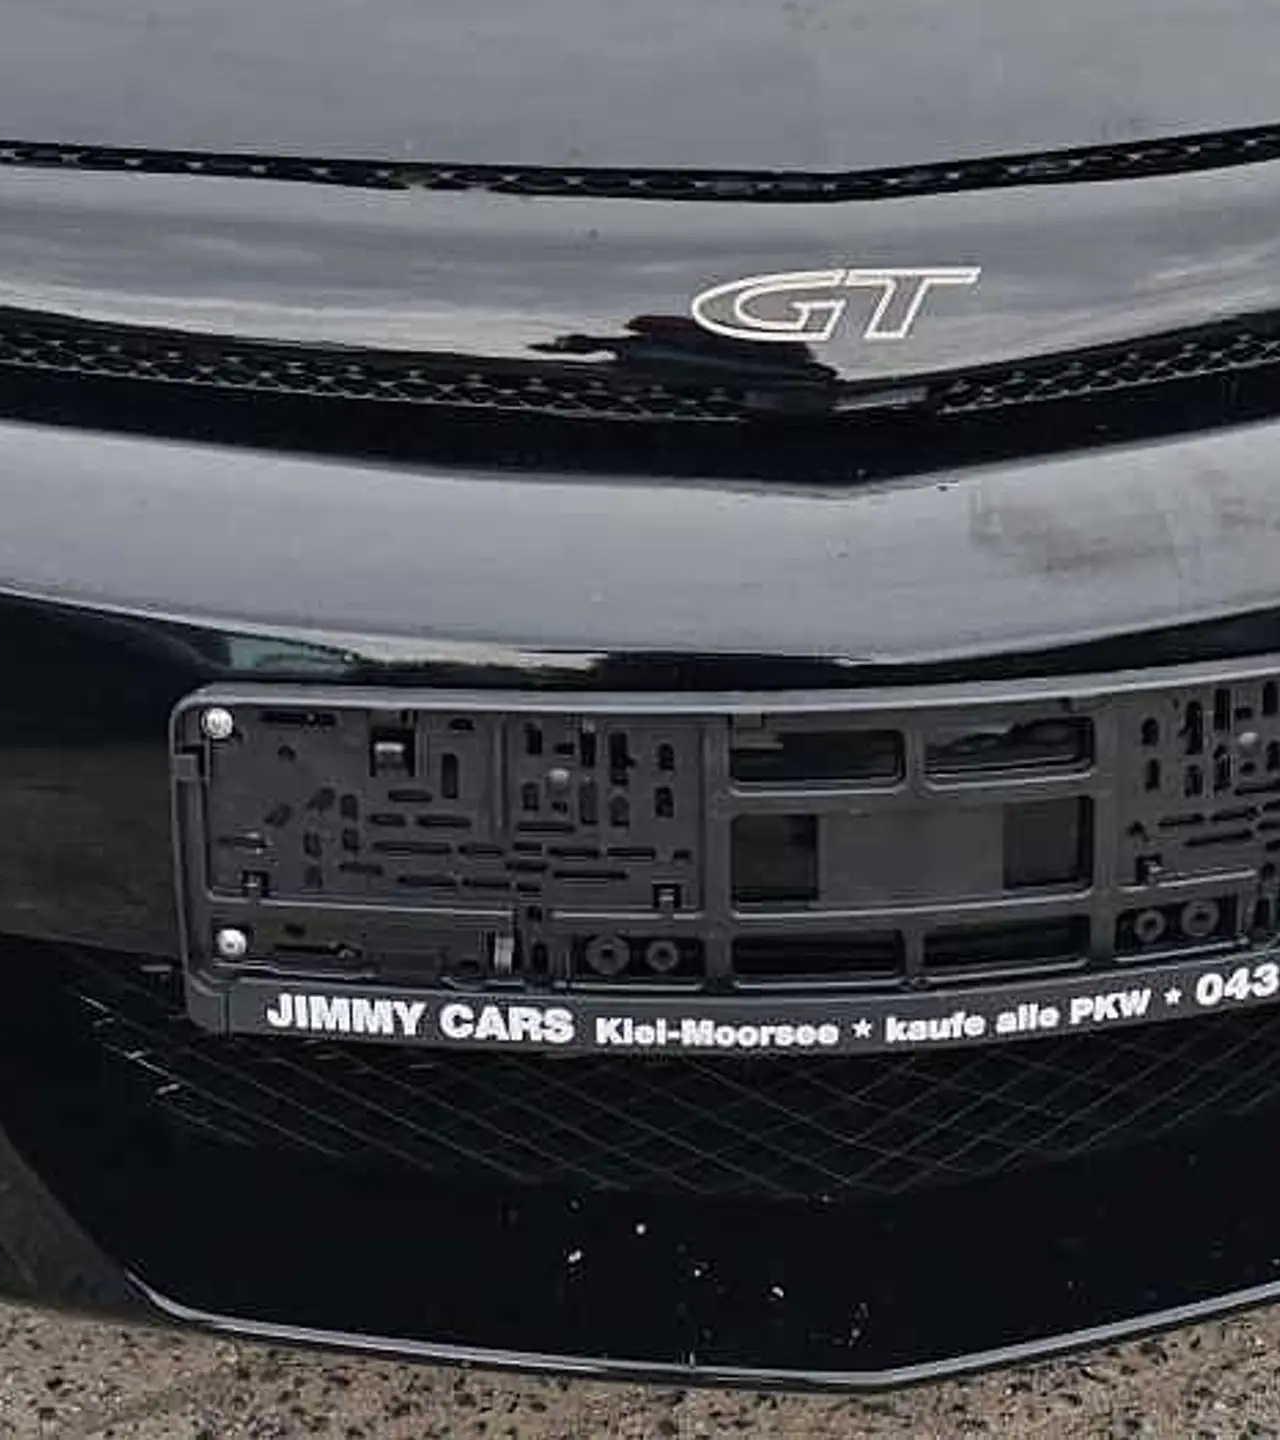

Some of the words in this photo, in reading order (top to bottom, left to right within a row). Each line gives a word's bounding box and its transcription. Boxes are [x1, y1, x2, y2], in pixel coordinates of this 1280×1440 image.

[691, 265, 981, 342] GT
[266, 992, 427, 1037] JIMMY
[439, 1003, 575, 1044] CARS
[595, 1017, 840, 1048] Kiel-Moorsee
[885, 1010, 986, 1043] kaufe
[995, 1002, 1060, 1034] alle
[1069, 988, 1152, 1025] PKW
